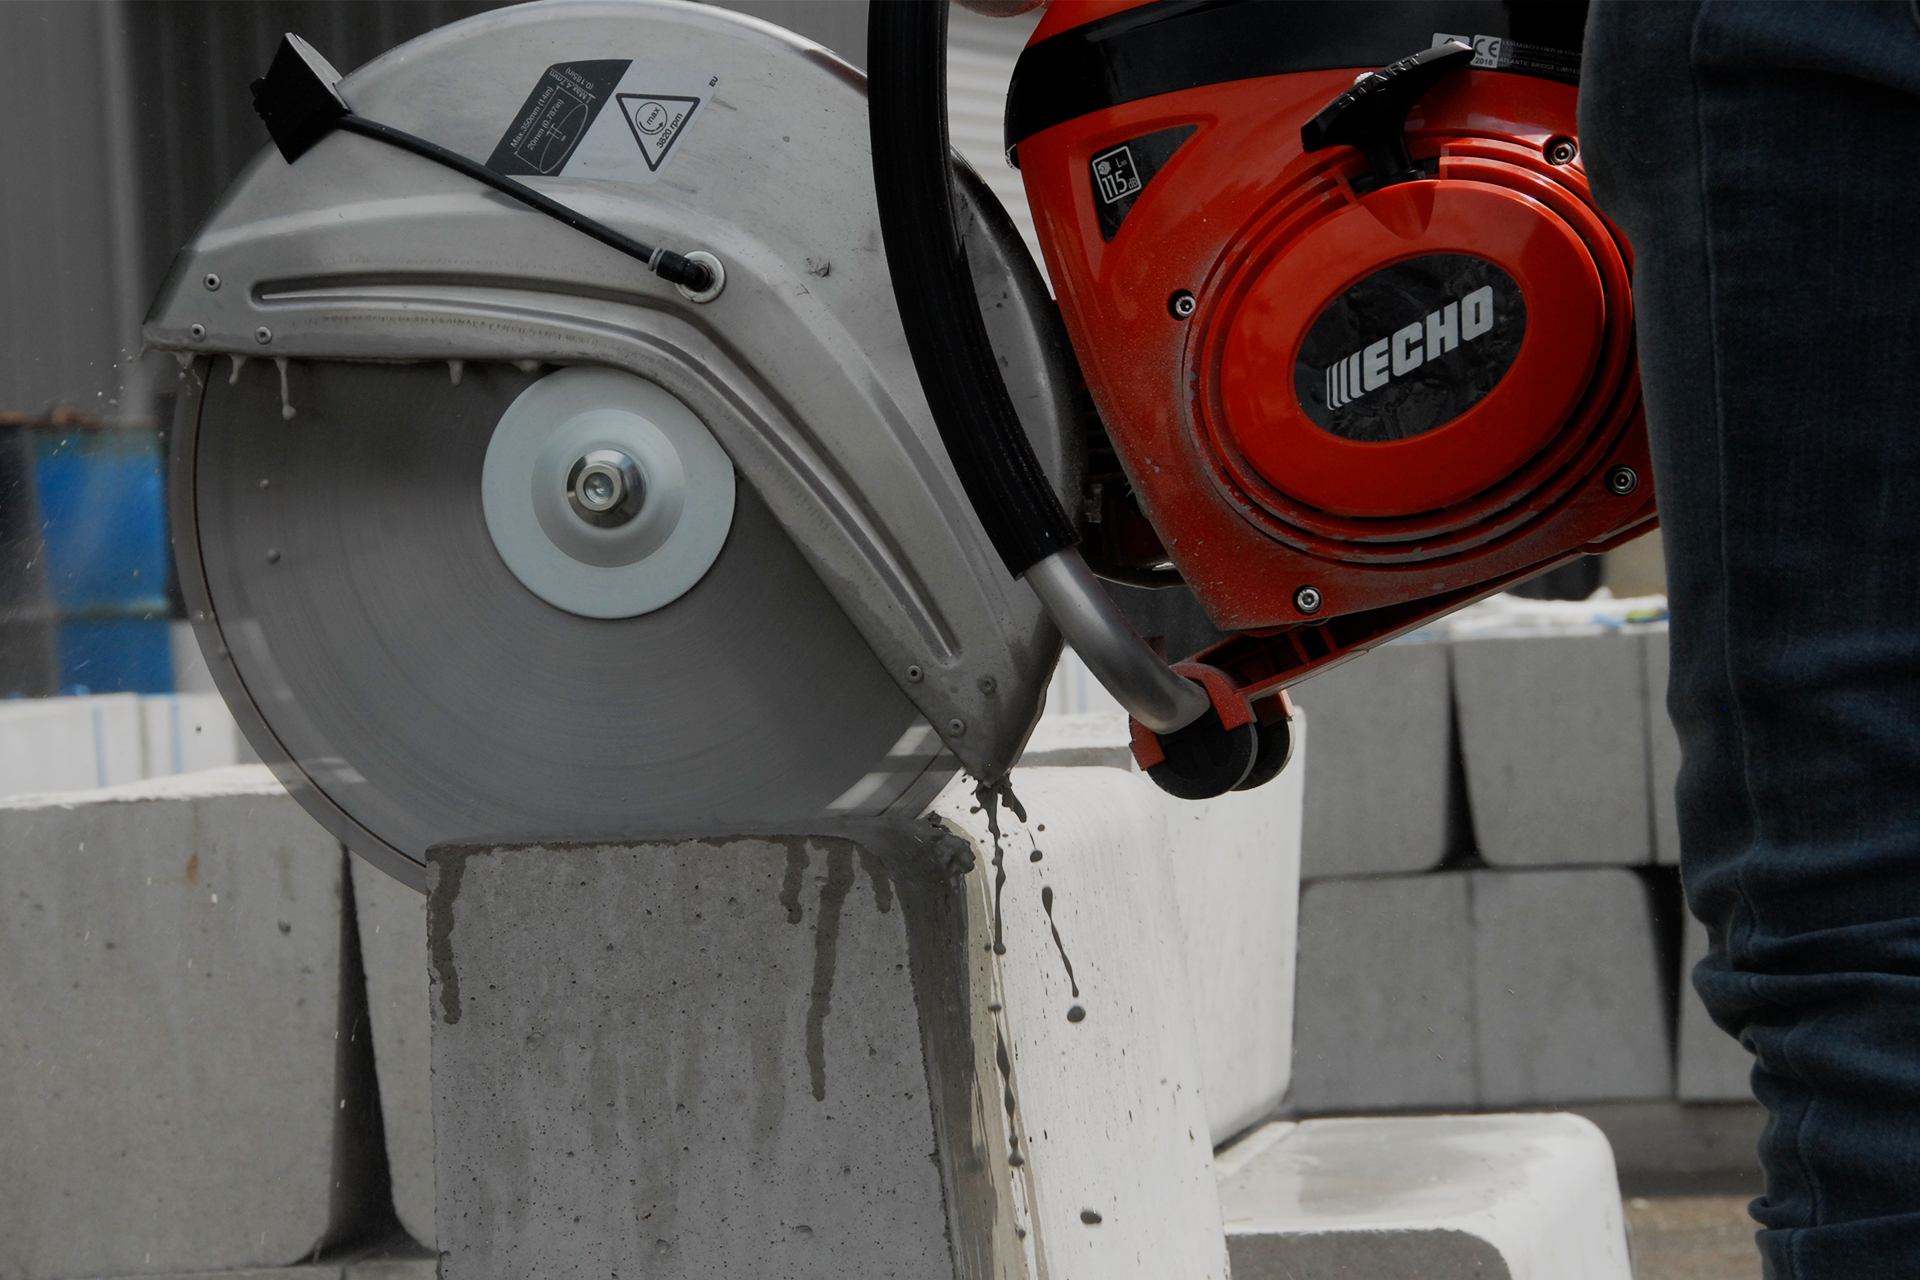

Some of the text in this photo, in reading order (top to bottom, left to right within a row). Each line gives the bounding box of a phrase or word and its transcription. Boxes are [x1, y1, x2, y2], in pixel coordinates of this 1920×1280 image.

[1474, 38, 1500, 58] CE
[1474, 57, 1493, 67] 2018
[1499, 57, 1530, 67] ATLANTIC
[1530, 62, 1556, 71] BRIDGE
[565, 66, 595, 90] (0.185in)
[708, 75, 719, 88] EU
[1338, 53, 1421, 110] START
[510, 86, 554, 148] Max.350mm (14in)
[527, 98, 565, 151] 20mm (0.787in)
[646, 107, 661, 126] max
[655, 112, 684, 149] 3820 rpm
[1101, 170, 1138, 198] 115 dB
[1362, 285, 1494, 392] ECHO
